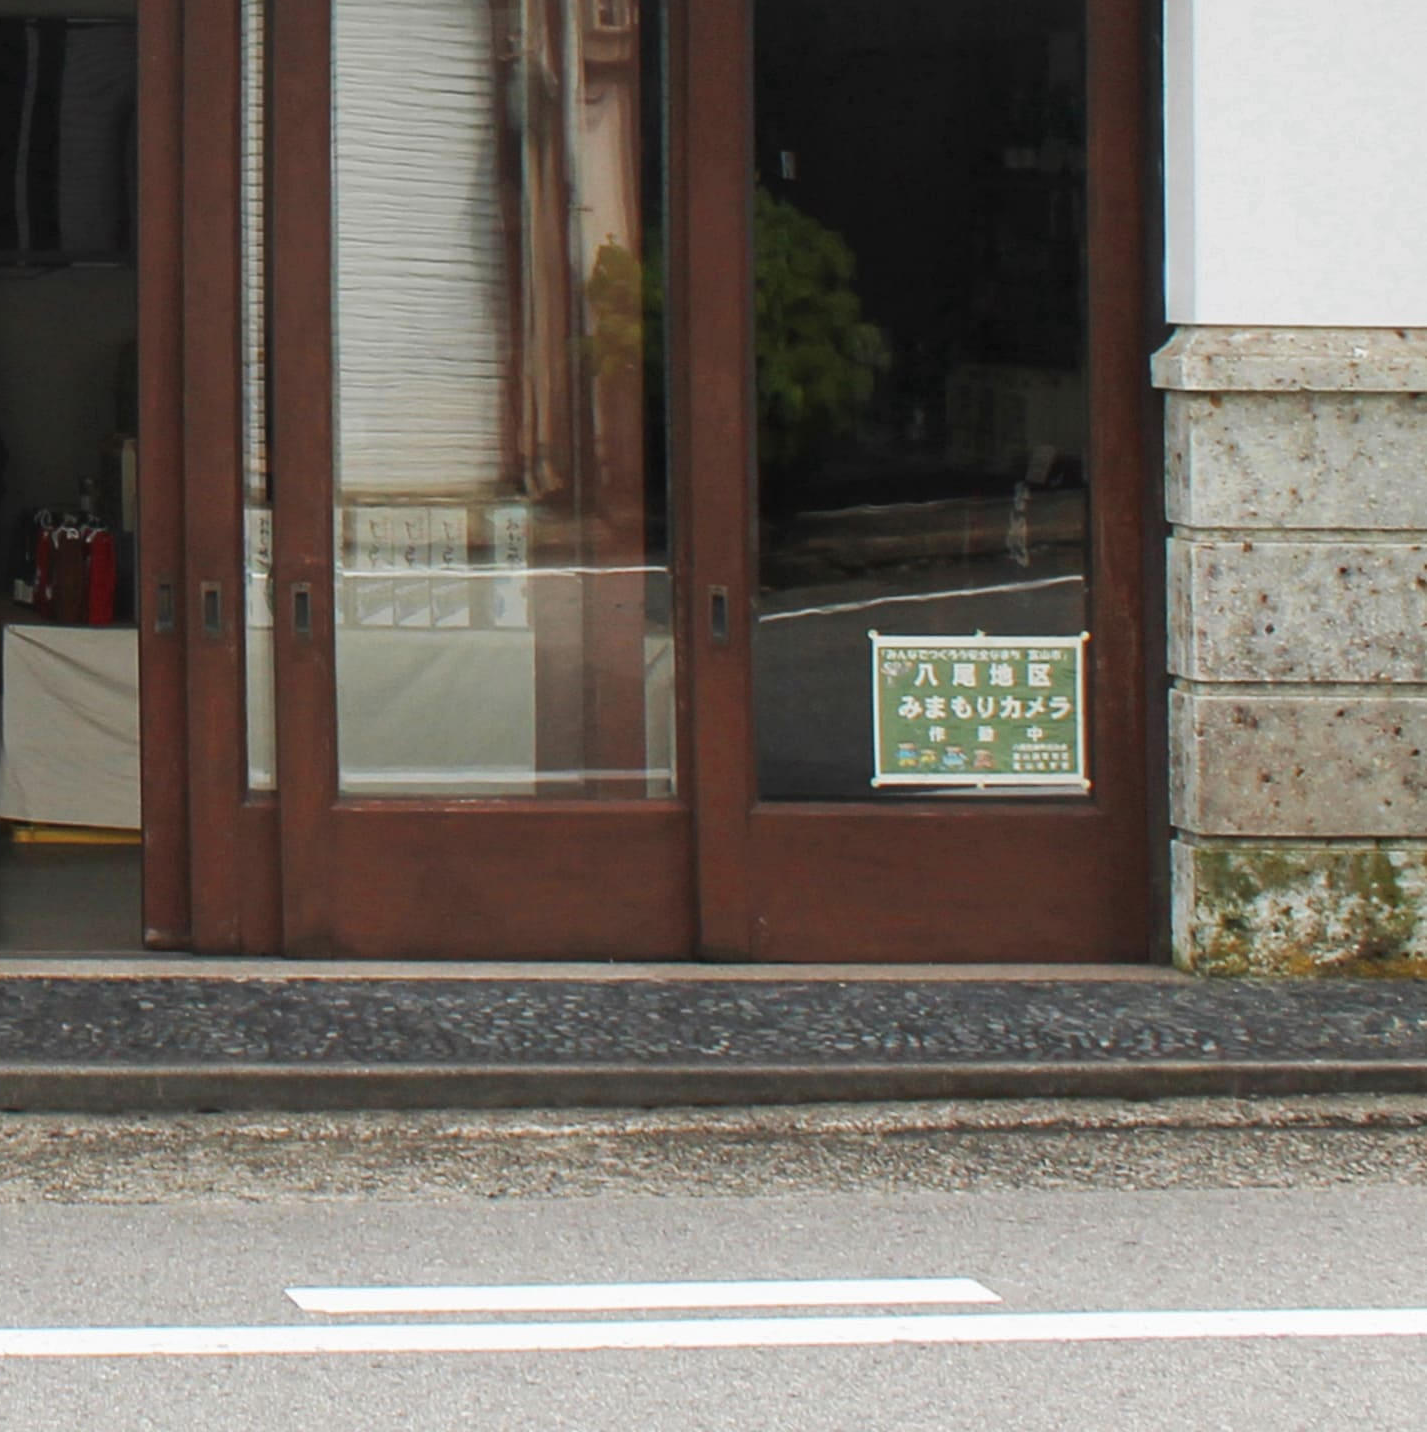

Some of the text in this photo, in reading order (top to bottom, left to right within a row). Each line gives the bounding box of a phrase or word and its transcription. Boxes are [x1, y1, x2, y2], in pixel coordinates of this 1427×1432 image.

[914, 663, 1052, 687] 八尾地区
[897, 695, 1072, 719] みまもりカメラ
[929, 725, 1044, 742] 作動中
